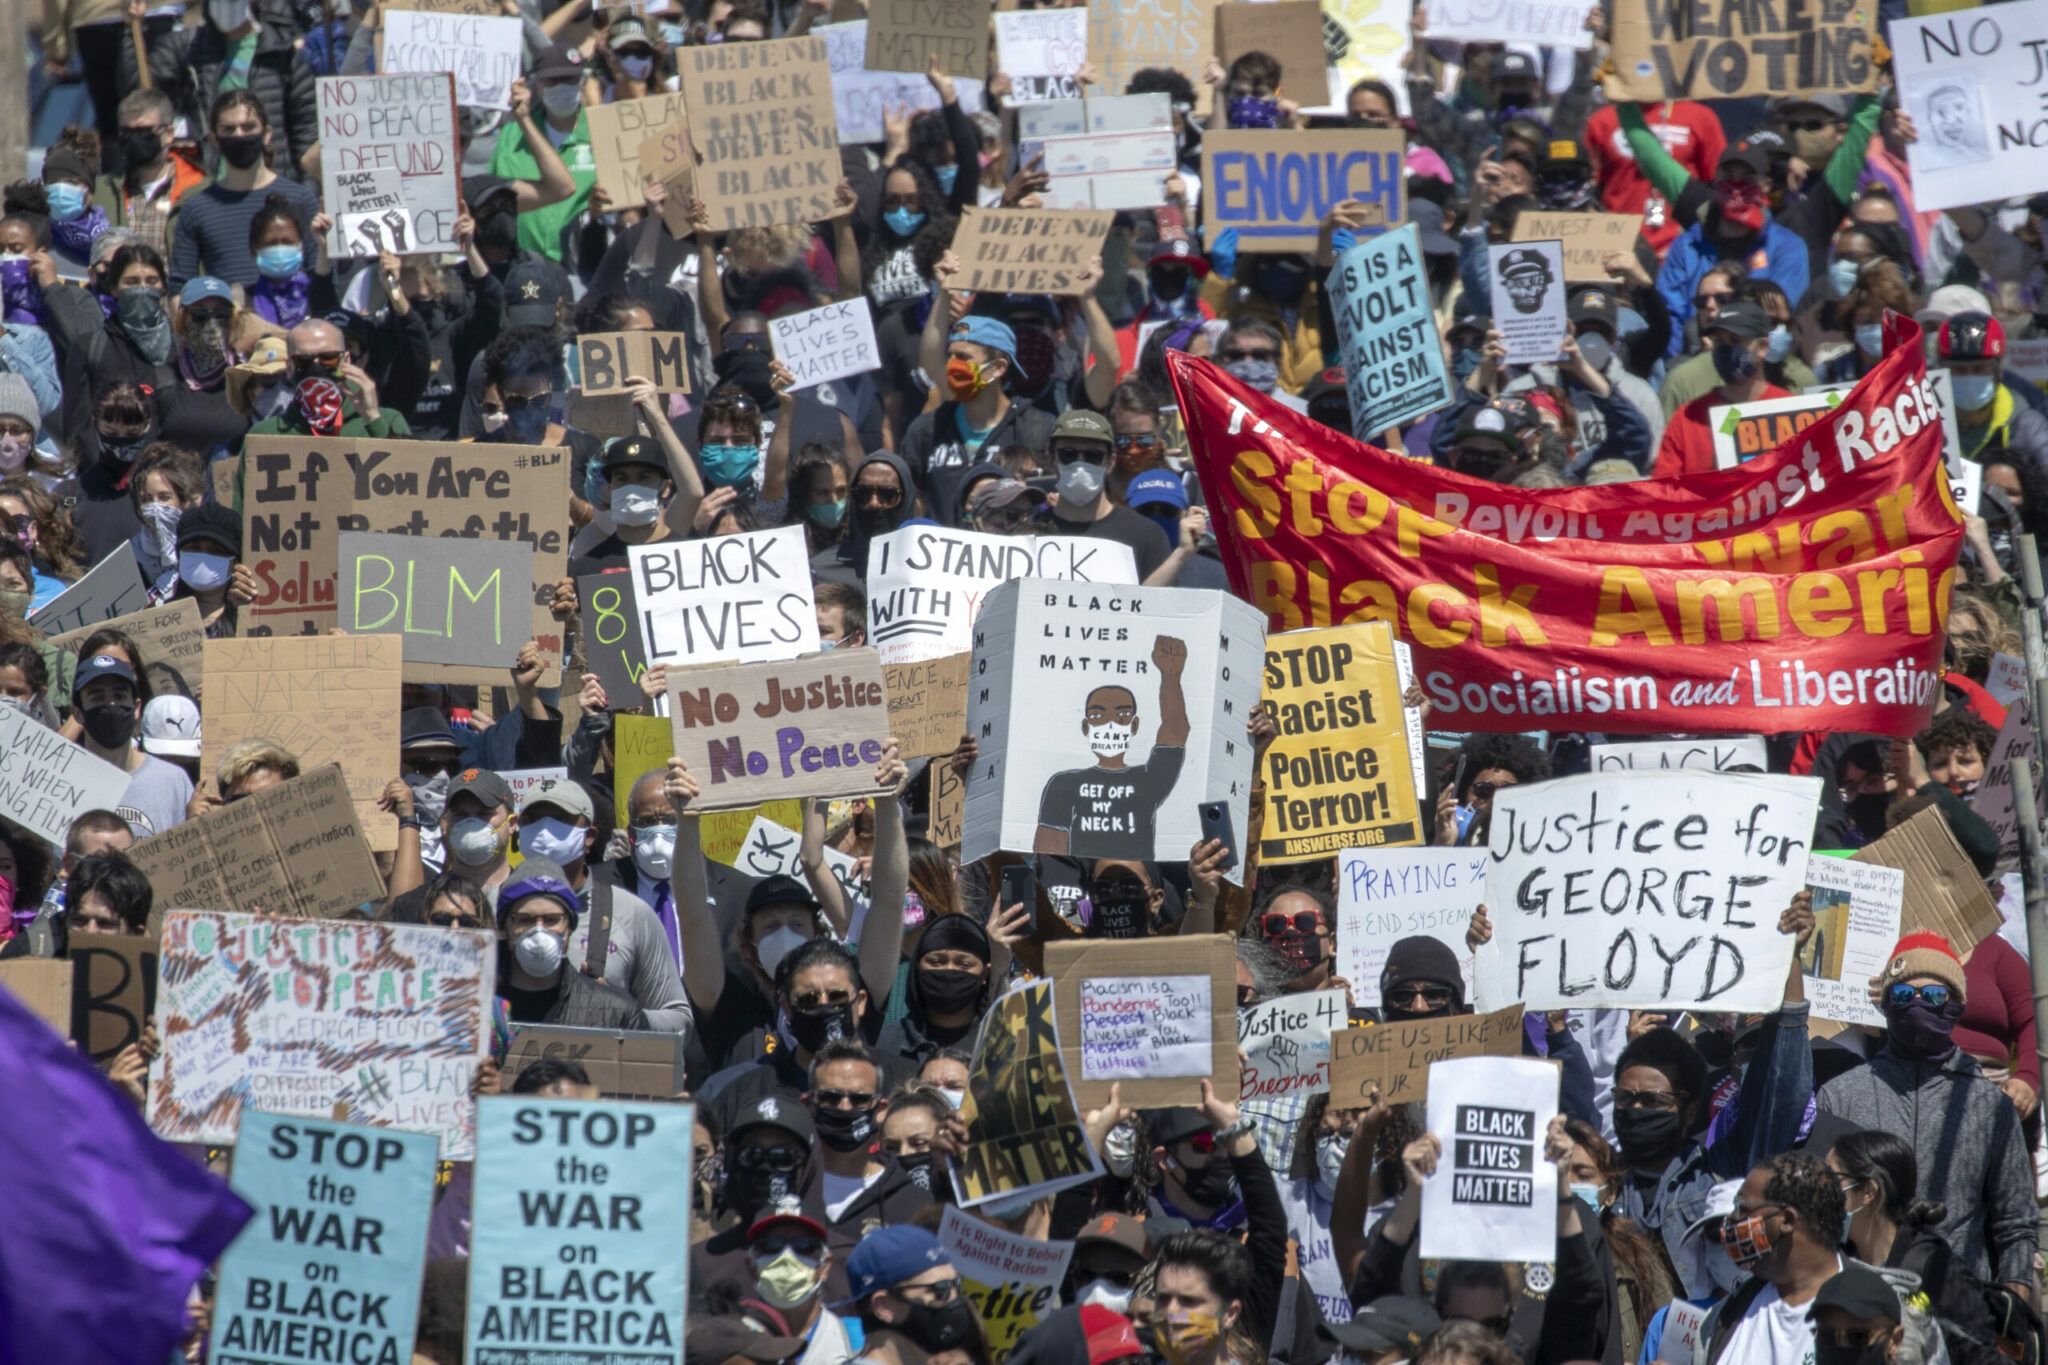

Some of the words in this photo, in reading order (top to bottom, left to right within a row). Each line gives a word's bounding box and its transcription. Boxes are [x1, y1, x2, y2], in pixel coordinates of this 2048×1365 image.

[411, 14, 485, 47] POLICE
[1090, 20, 1200, 55] TRANS
[1920, 17, 2002, 63] NO
[693, 40, 827, 72] DEFEND
[877, 32, 977, 75] MATTER
[1652, 27, 1869, 98] VOTING
[323, 80, 357, 107] NO
[367, 76, 448, 103] JUSTICE
[703, 72, 814, 106] BLACK
[325, 112, 358, 137] NO
[368, 104, 448, 139] PEACE
[709, 104, 815, 139] LIVES
[706, 124, 838, 162] DEFEND
[337, 172, 375, 187] BLACK
[718, 160, 828, 195] BLACK
[1213, 150, 1399, 222] ENOUGH
[726, 192, 831, 229] LIVES
[979, 215, 1109, 238] DEFEND
[1530, 218, 1592, 237] INVEST
[976, 241, 1083, 264] BLACK
[1364, 252, 1388, 283] IS
[1398, 243, 1414, 271] A
[972, 268, 1072, 290] LIVES
[777, 303, 853, 338] BLACK
[783, 323, 858, 359] LIVES
[786, 343, 872, 382] MATTER
[255, 451, 330, 502] If
[344, 451, 419, 500] You
[427, 457, 511, 499] Are
[514, 453, 561, 469] #BLM
[1230, 450, 1457, 558] Stop
[1621, 439, 1827, 543] Against
[251, 512, 320, 552] Not
[641, 537, 781, 596] BLACK
[881, 541, 890, 575] I
[905, 533, 1034, 582] STAND
[356, 554, 502, 645] BLM
[871, 587, 951, 626] WITH
[1044, 593, 1143, 613] BLACK
[1251, 561, 1550, 649] Black
[154, 612, 182, 628] FOR
[644, 593, 809, 658] LIVES
[1044, 624, 1130, 641] LIVES
[216, 637, 275, 670] SAY
[296, 635, 388, 669] THEIR
[1040, 654, 1148, 675] MATTER
[1265, 643, 1353, 690] STOP
[224, 670, 374, 713] NAMES
[679, 687, 740, 728] No
[754, 674, 883, 718] Justice
[1426, 666, 1658, 716] Socialism
[1670, 666, 1741, 707] and
[1750, 657, 1938, 708] Liberation
[1263, 689, 1377, 737] Racist
[12, 720, 87, 774] WHAT
[707, 736, 768, 785] No
[776, 727, 882, 778] Peace
[22, 761, 86, 808] WHEN
[1270, 747, 1379, 790] Police
[1080, 783, 1104, 798] GET
[1108, 785, 1134, 799] OFF
[1092, 801, 1112, 814] MY
[1270, 782, 1391, 833] Terror!
[1285, 828, 1385, 855] ANSWERSF.ORG
[1491, 791, 1708, 863] Justice
[1735, 803, 1804, 865] for
[1344, 859, 1456, 902] PRAYING
[1516, 866, 1772, 928] GEORGE
[170, 918, 216, 955] NO
[226, 922, 372, 968] JUSTICE
[1518, 928, 1746, 1003] FLOYD
[273, 971, 312, 1008] NO
[333, 967, 439, 1012] PEACE
[1082, 981, 1143, 995] Racism
[1147, 981, 1159, 994] is
[1162, 985, 1173, 994] a
[1082, 996, 1160, 1013] Pandemic
[1084, 1009, 1144, 1029] Respect
[1153, 1007, 1195, 1021] Black
[1084, 1029, 1120, 1042] Lives
[1125, 1028, 1149, 1039] Like
[1156, 1023, 1179, 1035] You
[1239, 1007, 1308, 1043] Justice
[1316, 996, 1340, 1028] 4
[1335, 1028, 1393, 1060] LOVE
[1402, 1027, 1431, 1048] US
[1445, 1019, 1490, 1045] LIKE
[1496, 1012, 1523, 1033] YOU
[248, 1054, 270, 1068] WE
[279, 1053, 310, 1068] ARE
[1152, 1034, 1192, 1049] Black
[1409, 1047, 1456, 1069] LOVE
[252, 1073, 344, 1091] OPPRESSED
[1240, 1068, 1322, 1101] Breonna
[1360, 1075, 1412, 1099] OUR
[395, 1099, 466, 1127] LIVES
[512, 1108, 656, 1149] STOP
[1466, 1109, 1526, 1137] BLACK
[268, 1124, 404, 1172] STOP
[963, 1123, 1096, 1203] MATTER
[1468, 1143, 1520, 1169] LIVES
[556, 1156, 609, 1185] the
[1456, 1176, 1531, 1203] MATTER
[308, 1174, 356, 1206] the
[270, 1205, 384, 1254] WAR
[519, 1191, 643, 1231] WAR
[559, 1244, 597, 1264] on
[951, 1217, 959, 1230] It
[961, 1222, 970, 1238] is
[973, 1229, 1006, 1252] Right
[1010, 1243, 1024, 1257] to
[1027, 1247, 1064, 1262] Rebel
[956, 1238, 999, 1268] Against
[1003, 1258, 1048, 1276] Racism
[304, 1260, 339, 1283] on
[501, 1267, 656, 1305] BLACK
[245, 1278, 390, 1329] BLACK
[1677, 1311, 1687, 1326] It
[1689, 1315, 1699, 1331] is
[221, 1316, 399, 1365] AMERICA
[477, 1306, 673, 1347] AMERICA
